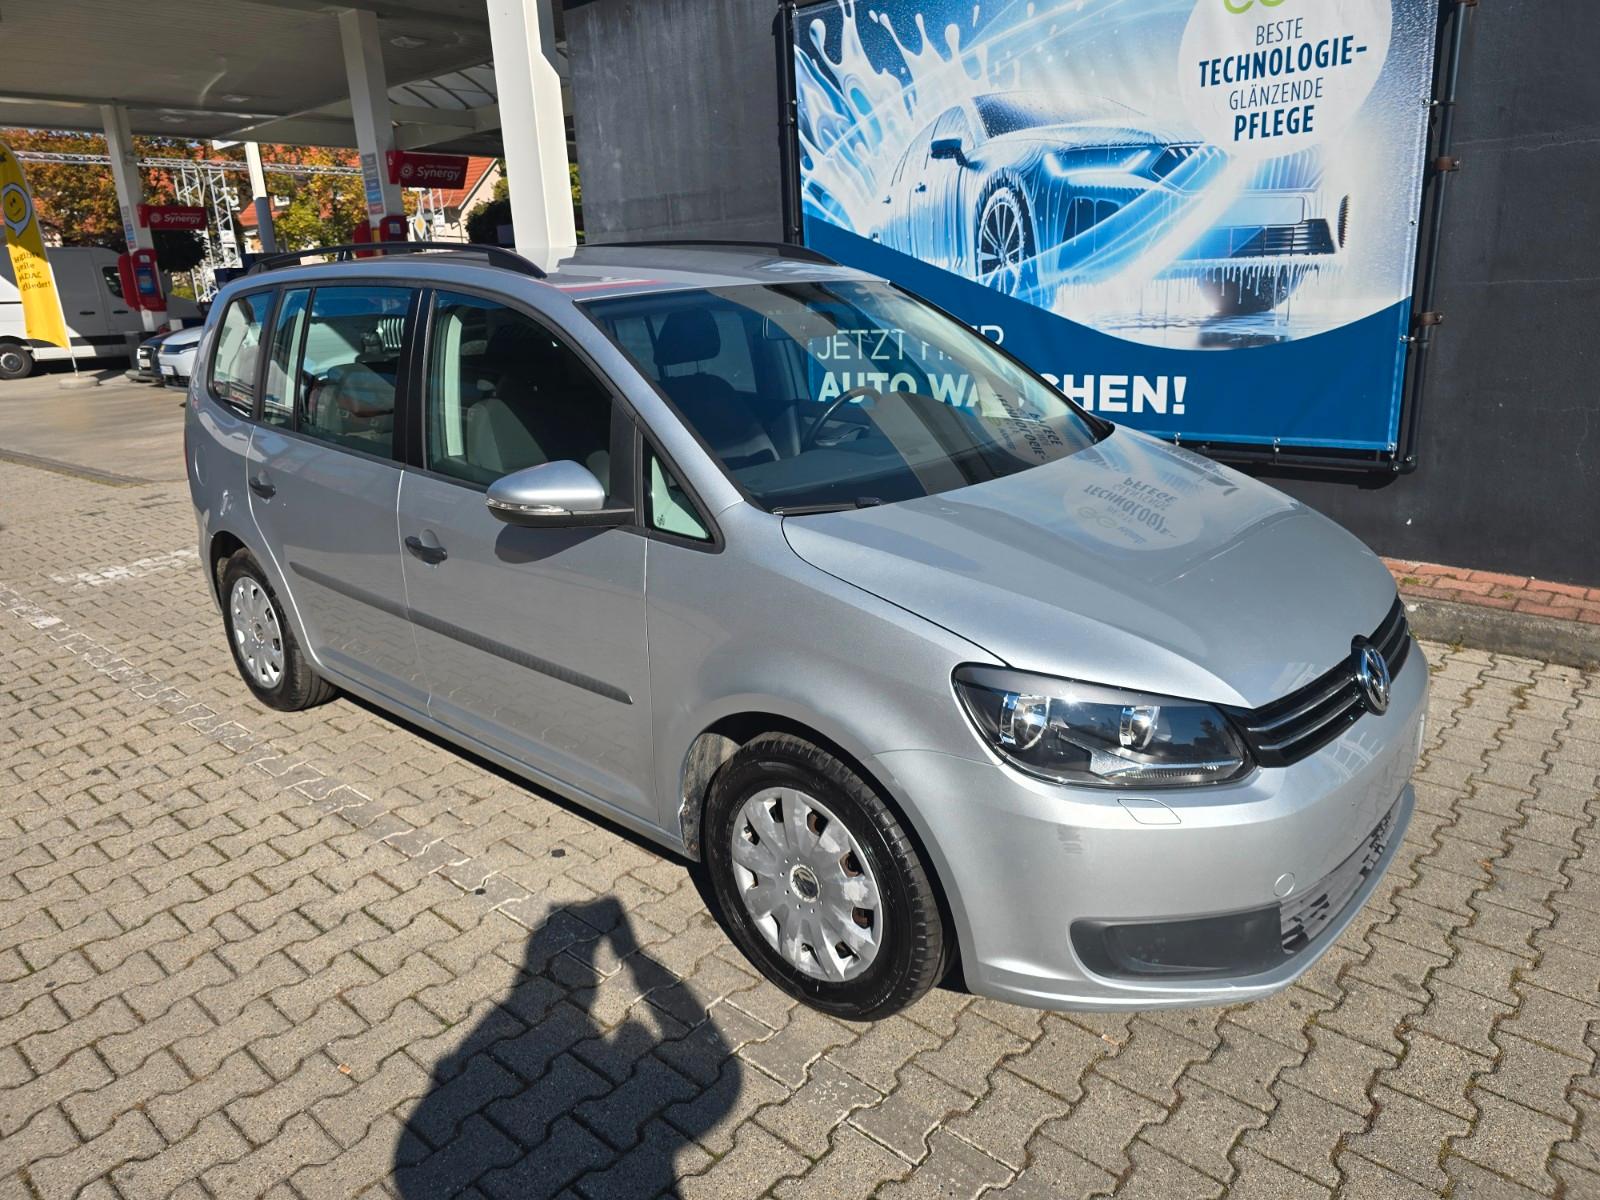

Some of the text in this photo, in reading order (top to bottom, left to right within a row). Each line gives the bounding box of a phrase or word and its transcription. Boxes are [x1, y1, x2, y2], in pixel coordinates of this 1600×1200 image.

[1255, 17, 1303, 46] BESTE
[1199, 35, 1367, 87] TECHNOLOGIE-
[1229, 77, 1323, 110] GLÄNZENDE
[1234, 105, 1314, 141] PFLEGE
[417, 166, 460, 181] Synergy
[164, 214, 200, 224] Synergy
[817, 328, 906, 360] JETZT
[818, 371, 917, 403] AUTO
